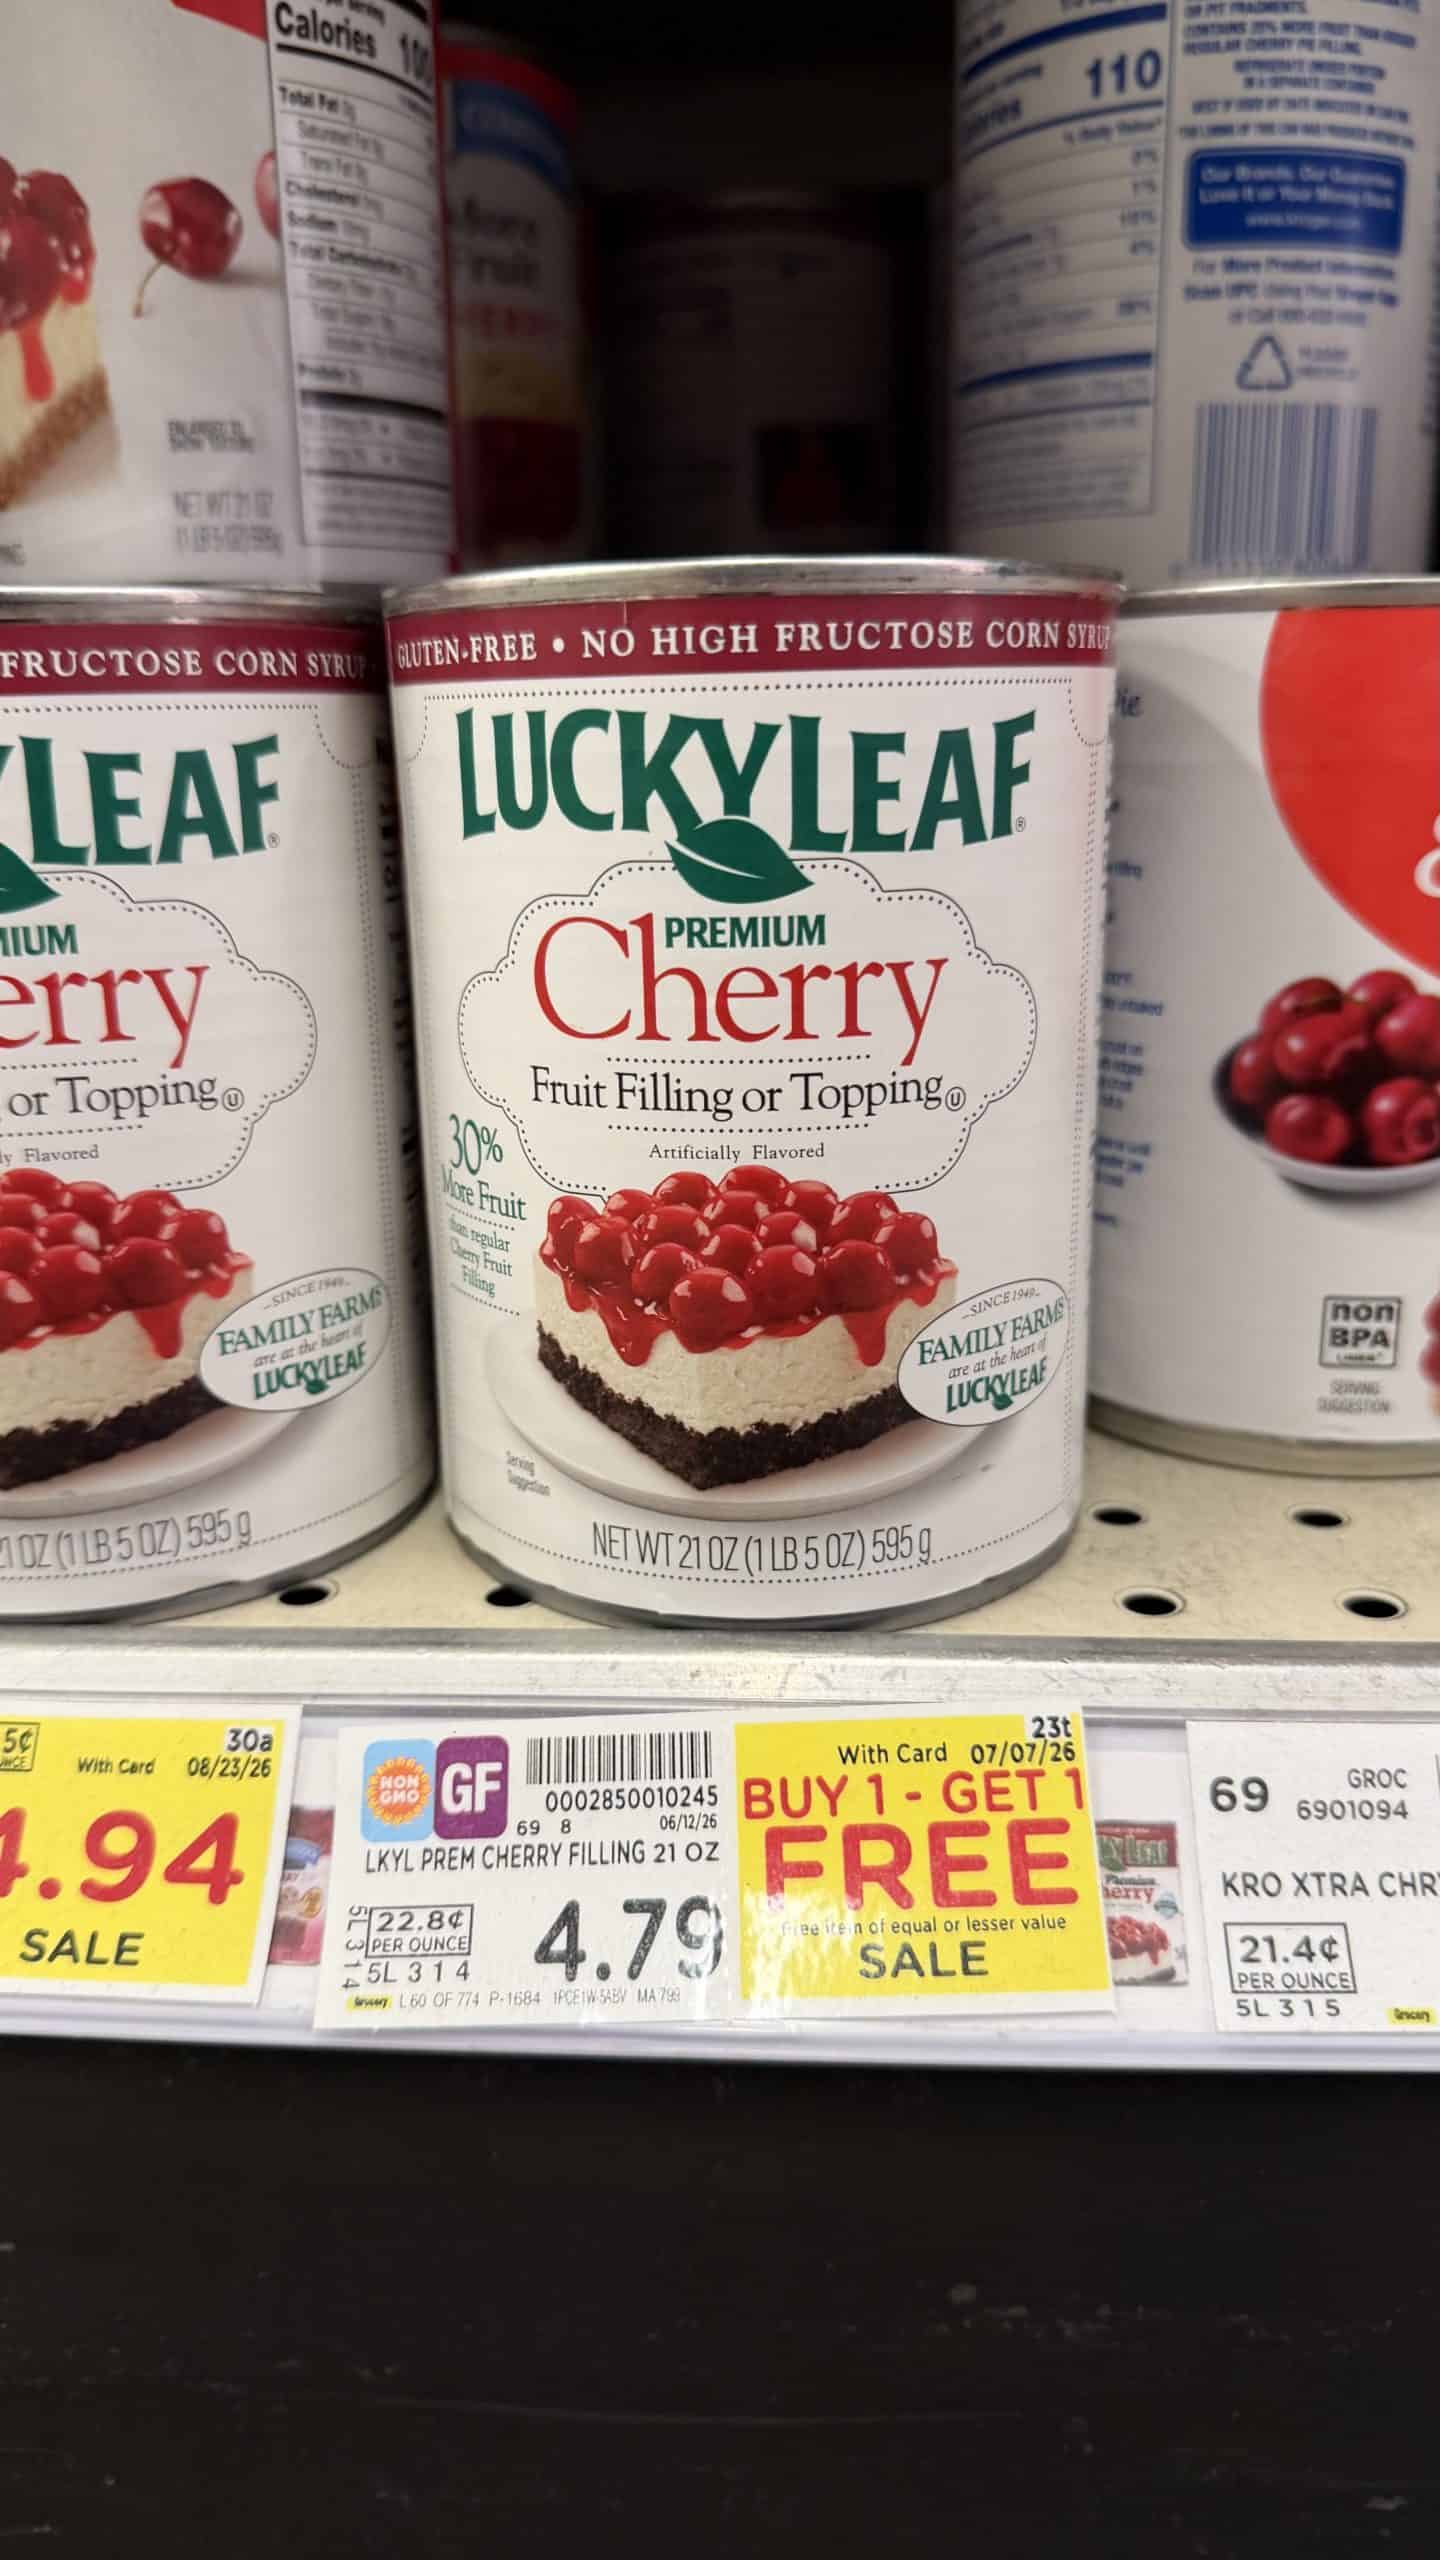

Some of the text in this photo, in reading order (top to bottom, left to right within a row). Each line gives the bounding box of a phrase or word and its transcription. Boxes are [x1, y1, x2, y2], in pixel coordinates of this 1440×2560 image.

[275, 1, 378, 60] Calories
[1086, 48, 1161, 99] 110
[397, 632, 538, 671] GLUTEN-FREE
[581, 628, 636, 658] NO
[651, 624, 759, 656] HIGH
[774, 621, 975, 652] FRUCTOSE
[985, 621, 1060, 649] CORN
[2, 649, 203, 678] FRUCTOSE
[214, 648, 299, 678] CORN
[664, 914, 826, 949] PREMIUM
[534, 912, 949, 1067] Cherry
[8, 1073, 217, 1119] or Topping
[530, 1064, 944, 1122] Fruit Filling or Topping
[23, 1143, 101, 1165] Flavored
[449, 1113, 504, 1176] 30%
[648, 1142, 826, 1165] Artificially Flavored
[441, 1163, 528, 1222] More Fruit
[471, 1230, 512, 1255] regular
[483, 1252, 513, 1278] Fruit
[272, 1279, 318, 1308] SINCE
[968, 1292, 1011, 1317] SINCE
[216, 1284, 383, 1356] FAMILY FARMS
[1331, 1303, 1395, 1323] non
[918, 1296, 1066, 1366] FAMILY FARMS
[1328, 1327, 1391, 1349] BPA
[254, 1353, 278, 1368] are
[299, 1339, 319, 1356] the
[948, 1364, 969, 1380] are
[973, 1358, 986, 1374] at
[989, 1351, 1009, 1370] the
[1010, 1342, 1037, 1362] heart
[17, 1508, 252, 1570] OZ (1 LB 5 OZ) 595 g
[592, 1521, 932, 1575] NET WT 21 OZ (1 LB 5 OZ) 595 g
[226, 1728, 273, 1752] 30a
[1031, 1717, 1073, 1738] 23t
[77, 1755, 272, 1780] With Card 08/23/26
[838, 1740, 1076, 1767] With Card 07/07/26
[379, 1774, 420, 1789] NON
[441, 1761, 503, 1815] GF
[743, 1774, 848, 1820] BUY
[867, 1773, 884, 1816] 1
[942, 1770, 1046, 1814] GET
[1064, 1767, 1084, 1810] 1
[1209, 1768, 1408, 1812] 69 GROC
[379, 1789, 420, 1807] GMO
[545, 1785, 719, 1813] 0002850010245
[1297, 1800, 1409, 1820] 6901094
[516, 1813, 718, 1836] 69 8 06/12/26
[365, 1839, 720, 1874] LKYL PREM CHERRY FILLING 21 OZ
[764, 1818, 1079, 1911] FREE
[1221, 1872, 1440, 1898] KRO XTRA CHR
[376, 1910, 465, 1932] 22.8¢
[869, 1917, 885, 1935] of
[891, 1916, 937, 1936] equal
[943, 1919, 961, 1933] or
[966, 1915, 1014, 1932] lesser
[1021, 1913, 1067, 1931] value
[19, 1928, 145, 1966] SALE
[372, 1935, 468, 1953] PER OUNCE
[535, 1895, 724, 1982] 4.79
[1240, 1935, 1340, 1964] 21.4¢
[367, 1959, 470, 1984] 5L 3 1 4
[858, 1941, 990, 1979] SALE
[1237, 1972, 1350, 1990] PER OUNCE
[433, 1992, 449, 2007] OF
[1236, 1999, 1340, 2017] 5L 3 1 5
